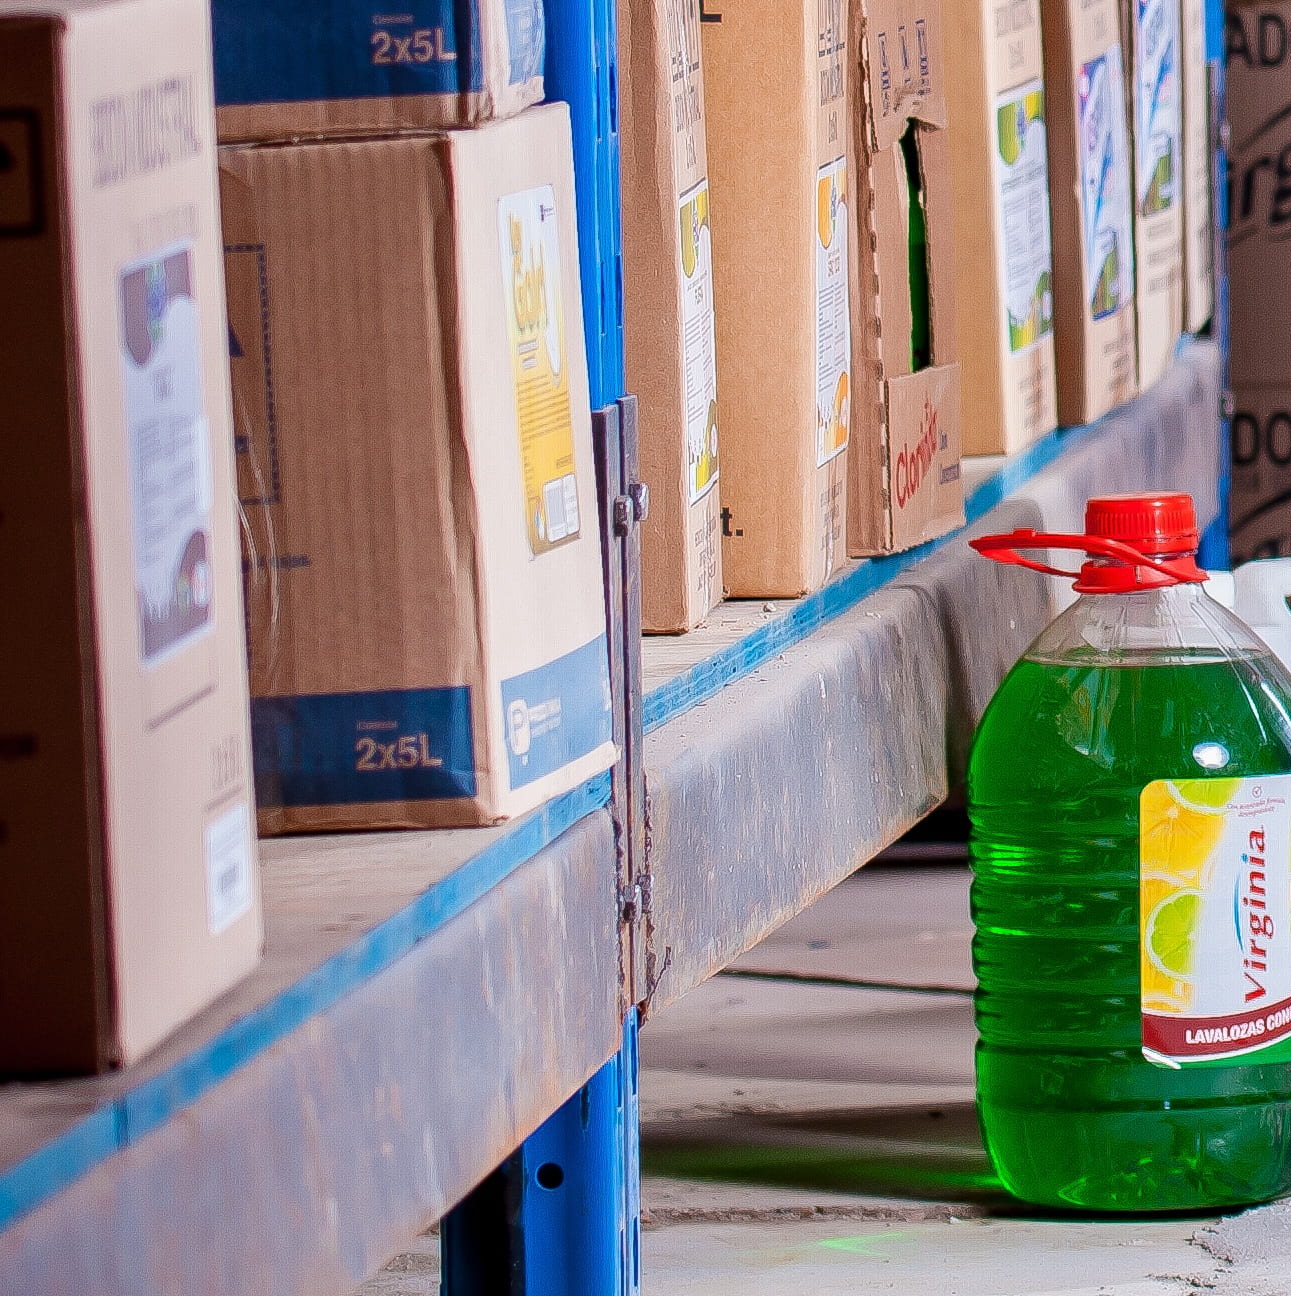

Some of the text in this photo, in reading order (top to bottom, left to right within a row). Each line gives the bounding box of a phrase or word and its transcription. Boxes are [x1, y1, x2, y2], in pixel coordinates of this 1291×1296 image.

[371, 27, 458, 65] 2x5L
[355, 732, 443, 772] 2x5L
[1242, 827, 1274, 1004] Virginia
[1185, 1019, 1266, 1045] LAVALOZAS
